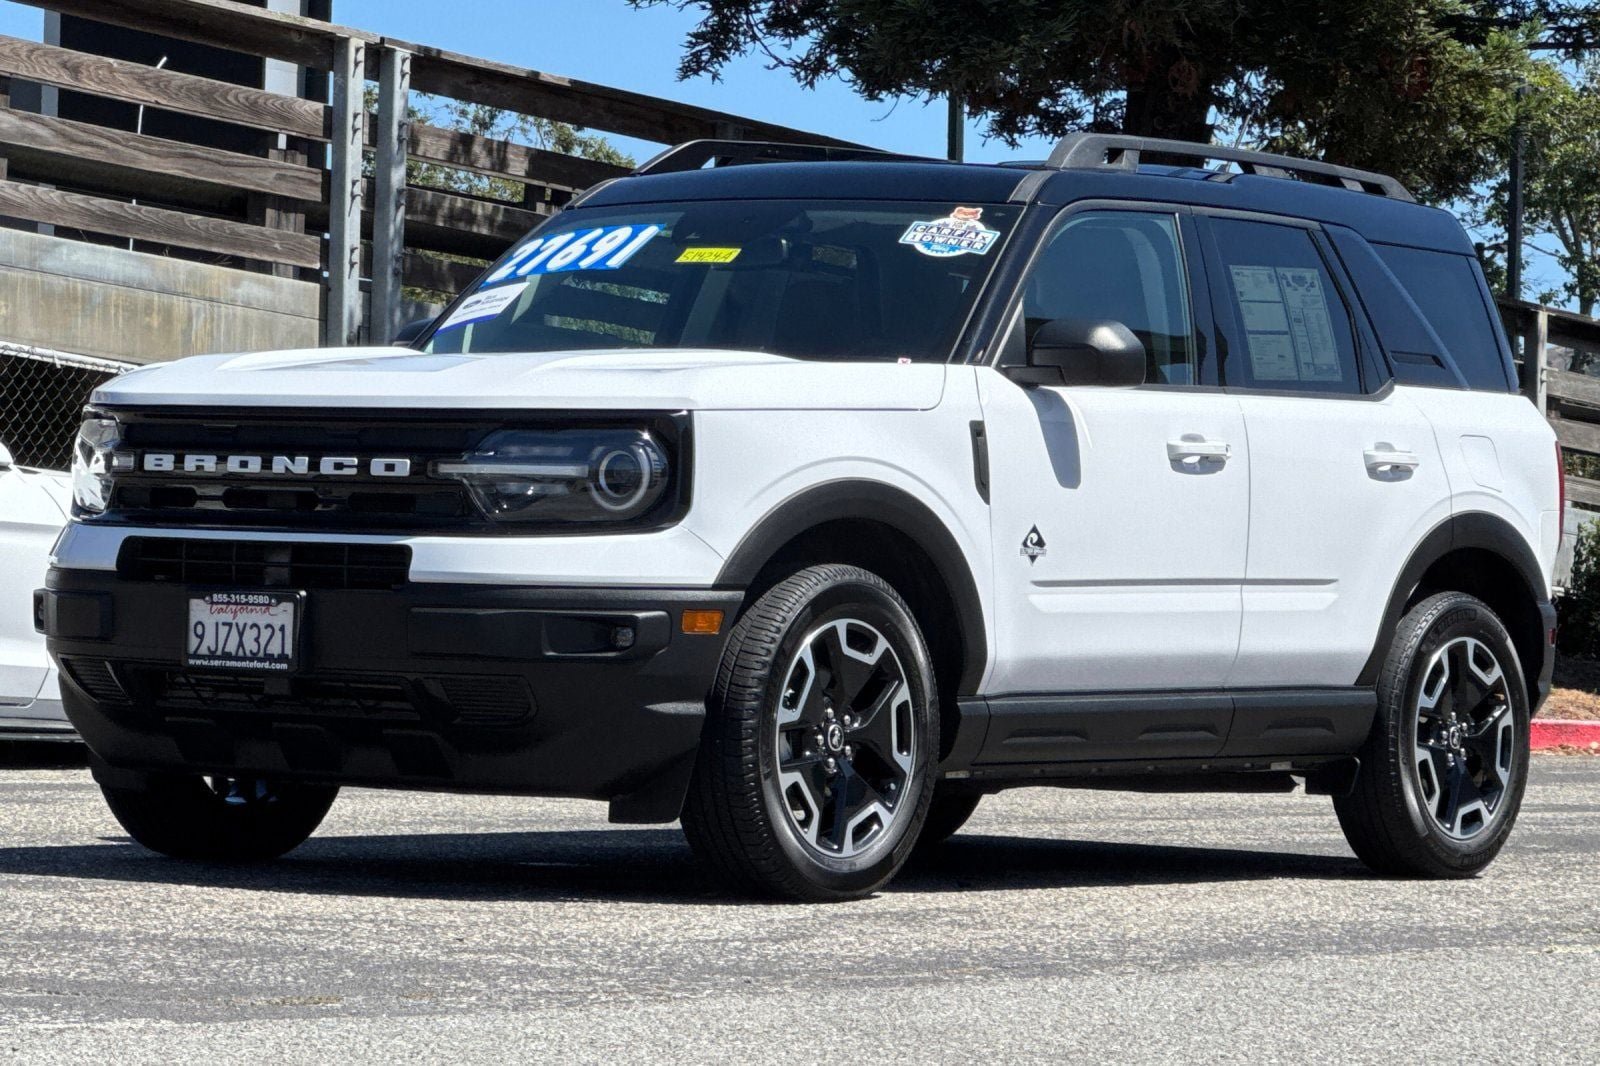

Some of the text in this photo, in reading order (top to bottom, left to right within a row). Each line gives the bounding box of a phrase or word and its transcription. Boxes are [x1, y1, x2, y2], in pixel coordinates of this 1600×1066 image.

[914, 225, 988, 241] CARFAX
[922, 234, 985, 250] OWNER
[486, 226, 660, 282] 27691
[143, 454, 410, 476] BRONCO
[212, 593, 270, 604] 855-315-9580
[210, 604, 277, 620] California
[193, 621, 289, 658] 9JZX321
[188, 658, 288, 670] www.serramonteford.com
